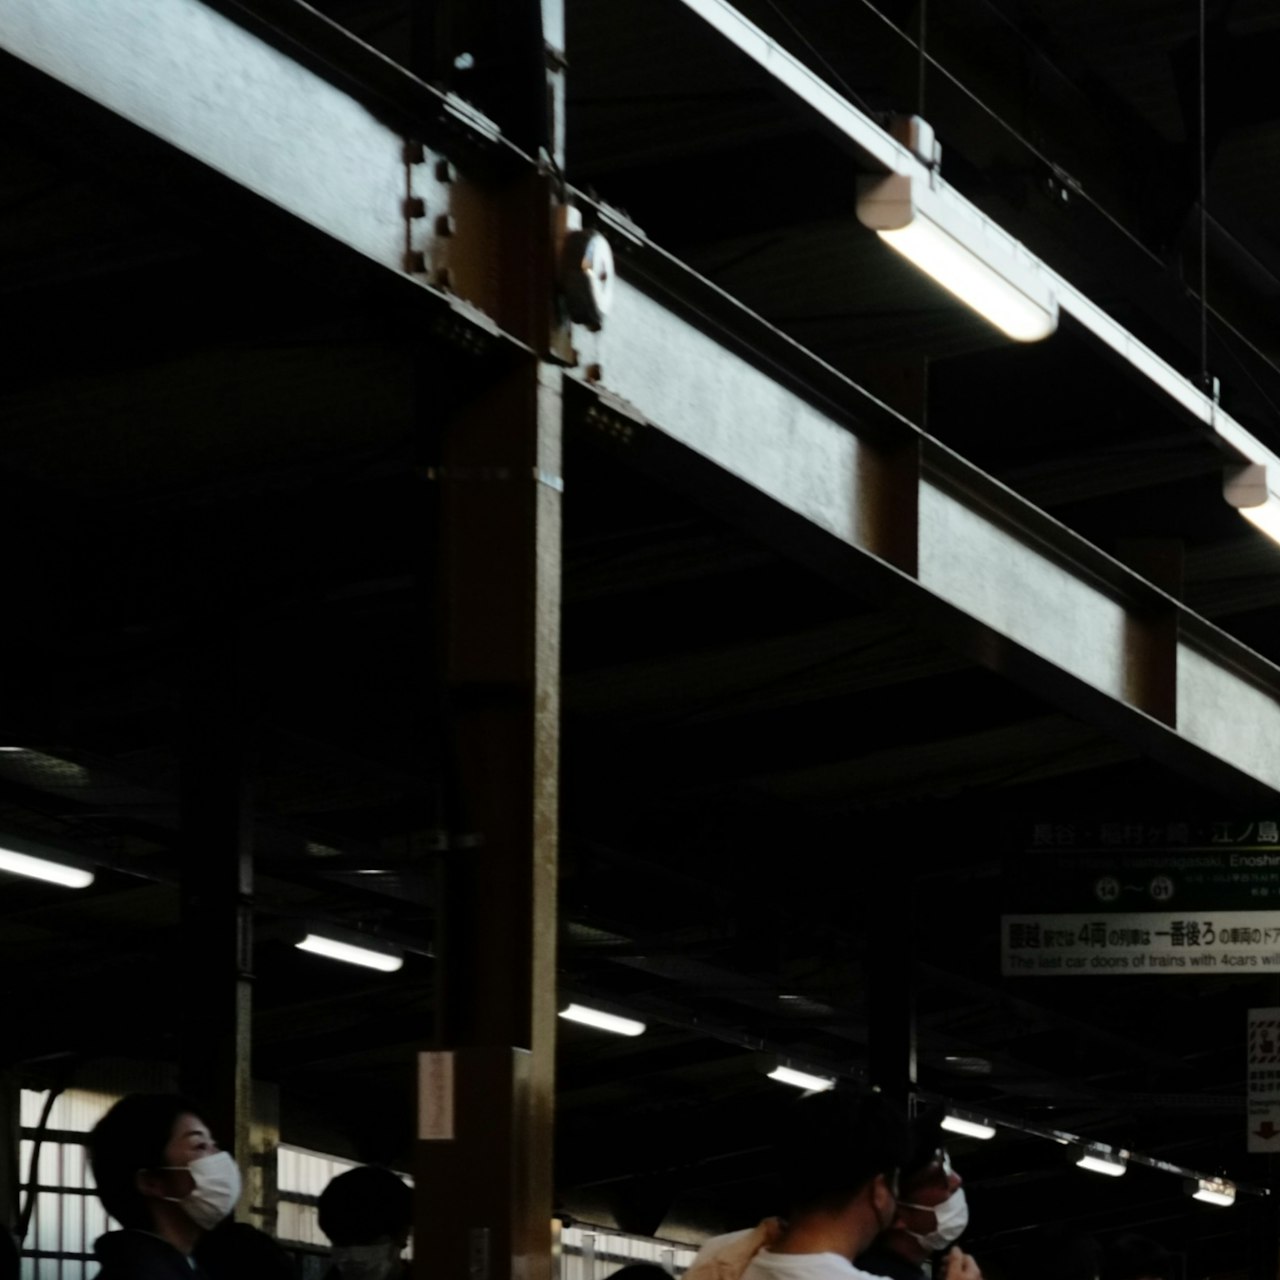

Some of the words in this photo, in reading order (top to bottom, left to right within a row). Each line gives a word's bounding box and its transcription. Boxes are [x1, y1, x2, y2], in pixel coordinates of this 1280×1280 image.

[1008, 954, 1034, 969] The
[1038, 954, 1062, 969] last
[1066, 957, 1087, 969] car
[1091, 954, 1128, 969] doors
[1132, 953, 1146, 968] of
[1149, 953, 1186, 967] trains
[1190, 953, 1217, 967] with
